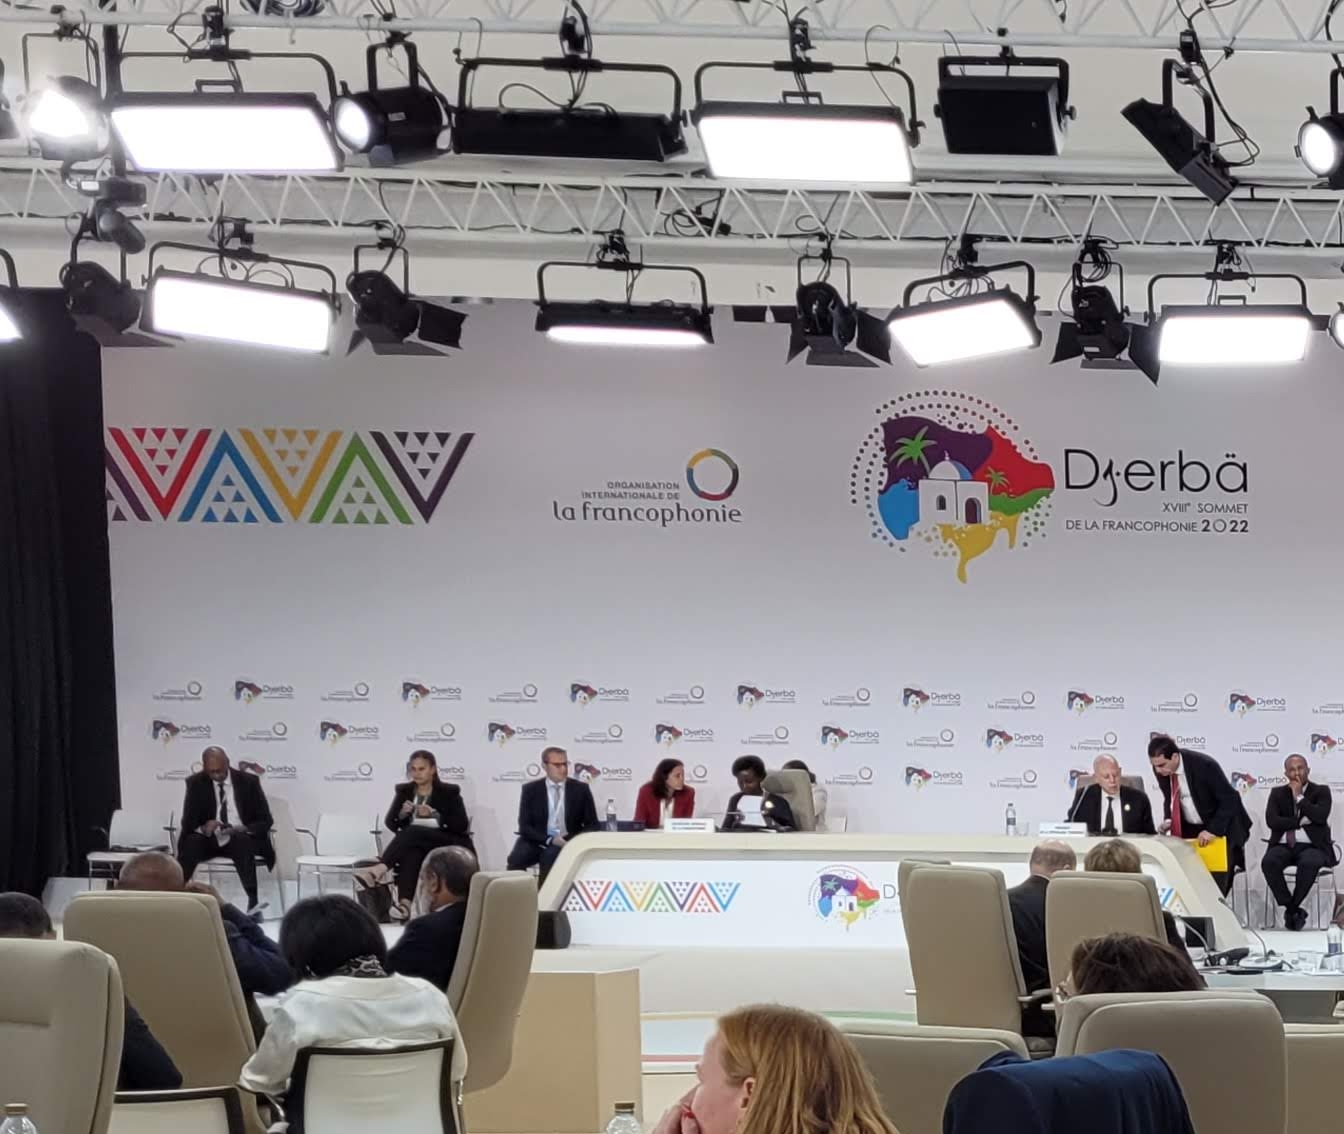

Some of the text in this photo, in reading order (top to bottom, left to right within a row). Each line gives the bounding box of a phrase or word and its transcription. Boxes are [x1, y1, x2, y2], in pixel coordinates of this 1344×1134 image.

[1063, 448, 1248, 507] Djerbä
[607, 481, 680, 490] ORGANISATION
[582, 491, 680, 500] INTERNATIONALE DE
[553, 500, 742, 527] la francophonie
[1197, 503, 1249, 514] SOMMET
[1065, 519, 1249, 533] DE LA FRANCOPHONIE 2022
